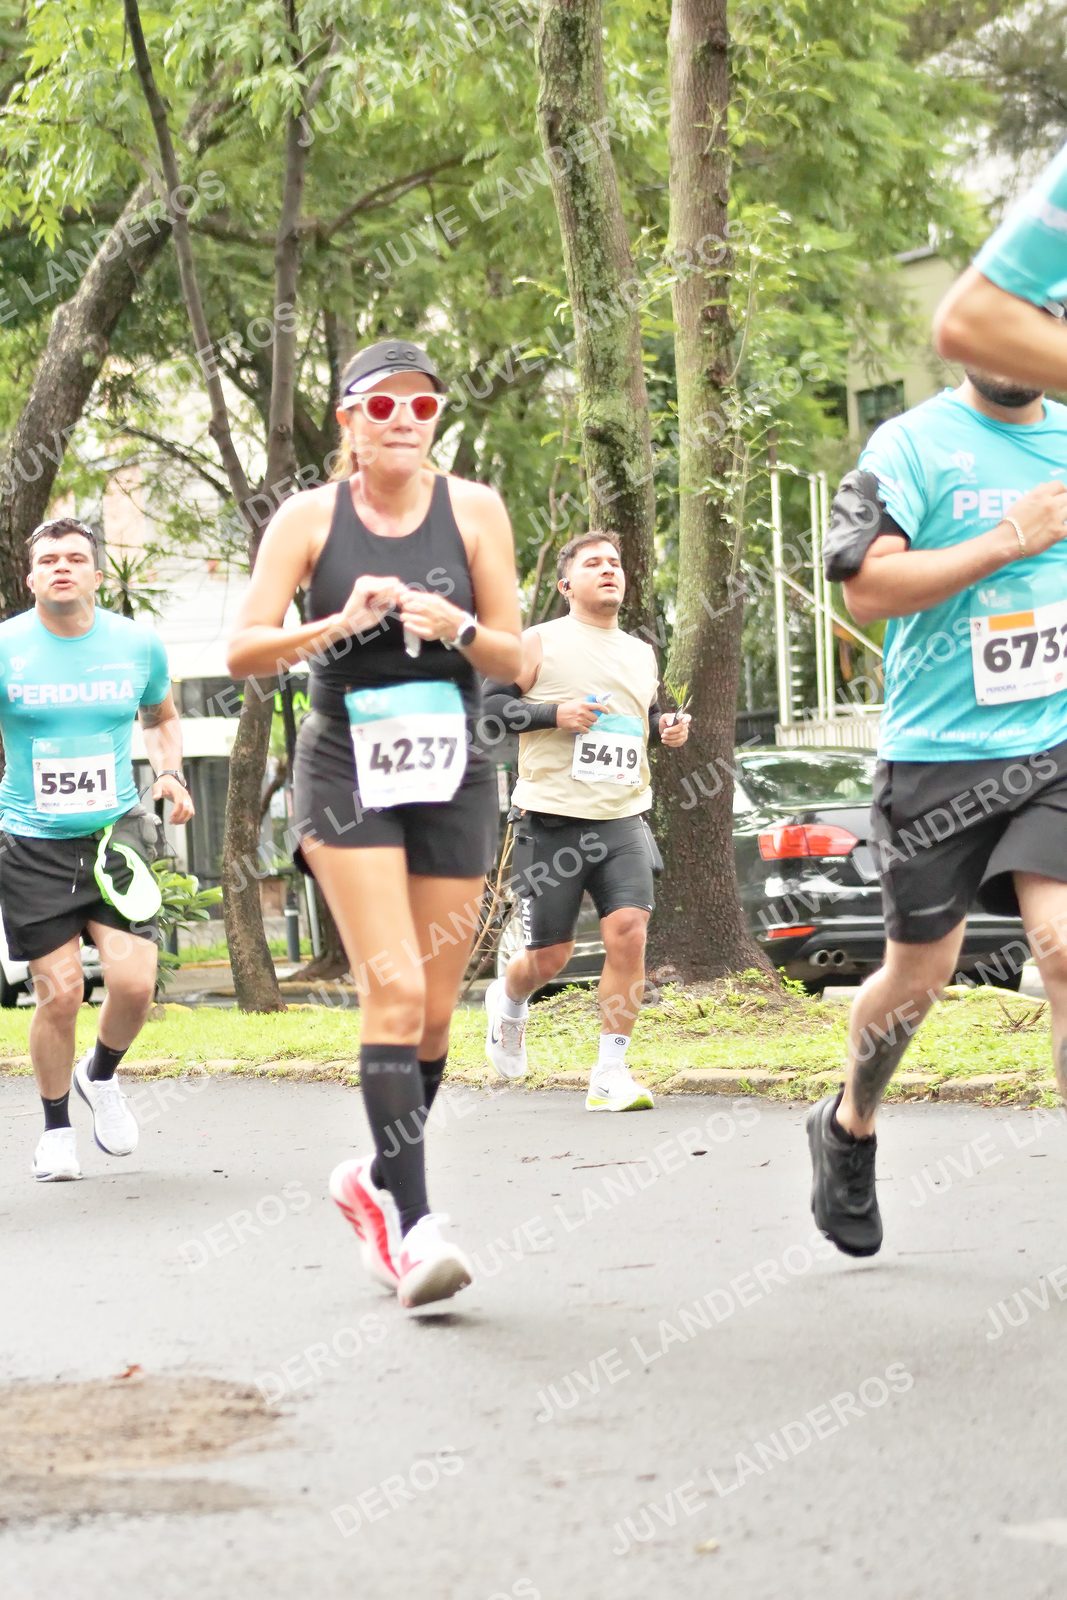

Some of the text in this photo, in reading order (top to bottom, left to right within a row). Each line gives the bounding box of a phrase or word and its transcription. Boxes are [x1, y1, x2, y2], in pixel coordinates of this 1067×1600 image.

[7, 680, 134, 705] PERDURA
[369, 737, 458, 775] 4237
[579, 742, 638, 769] 5419
[40, 769, 107, 795] 5541
